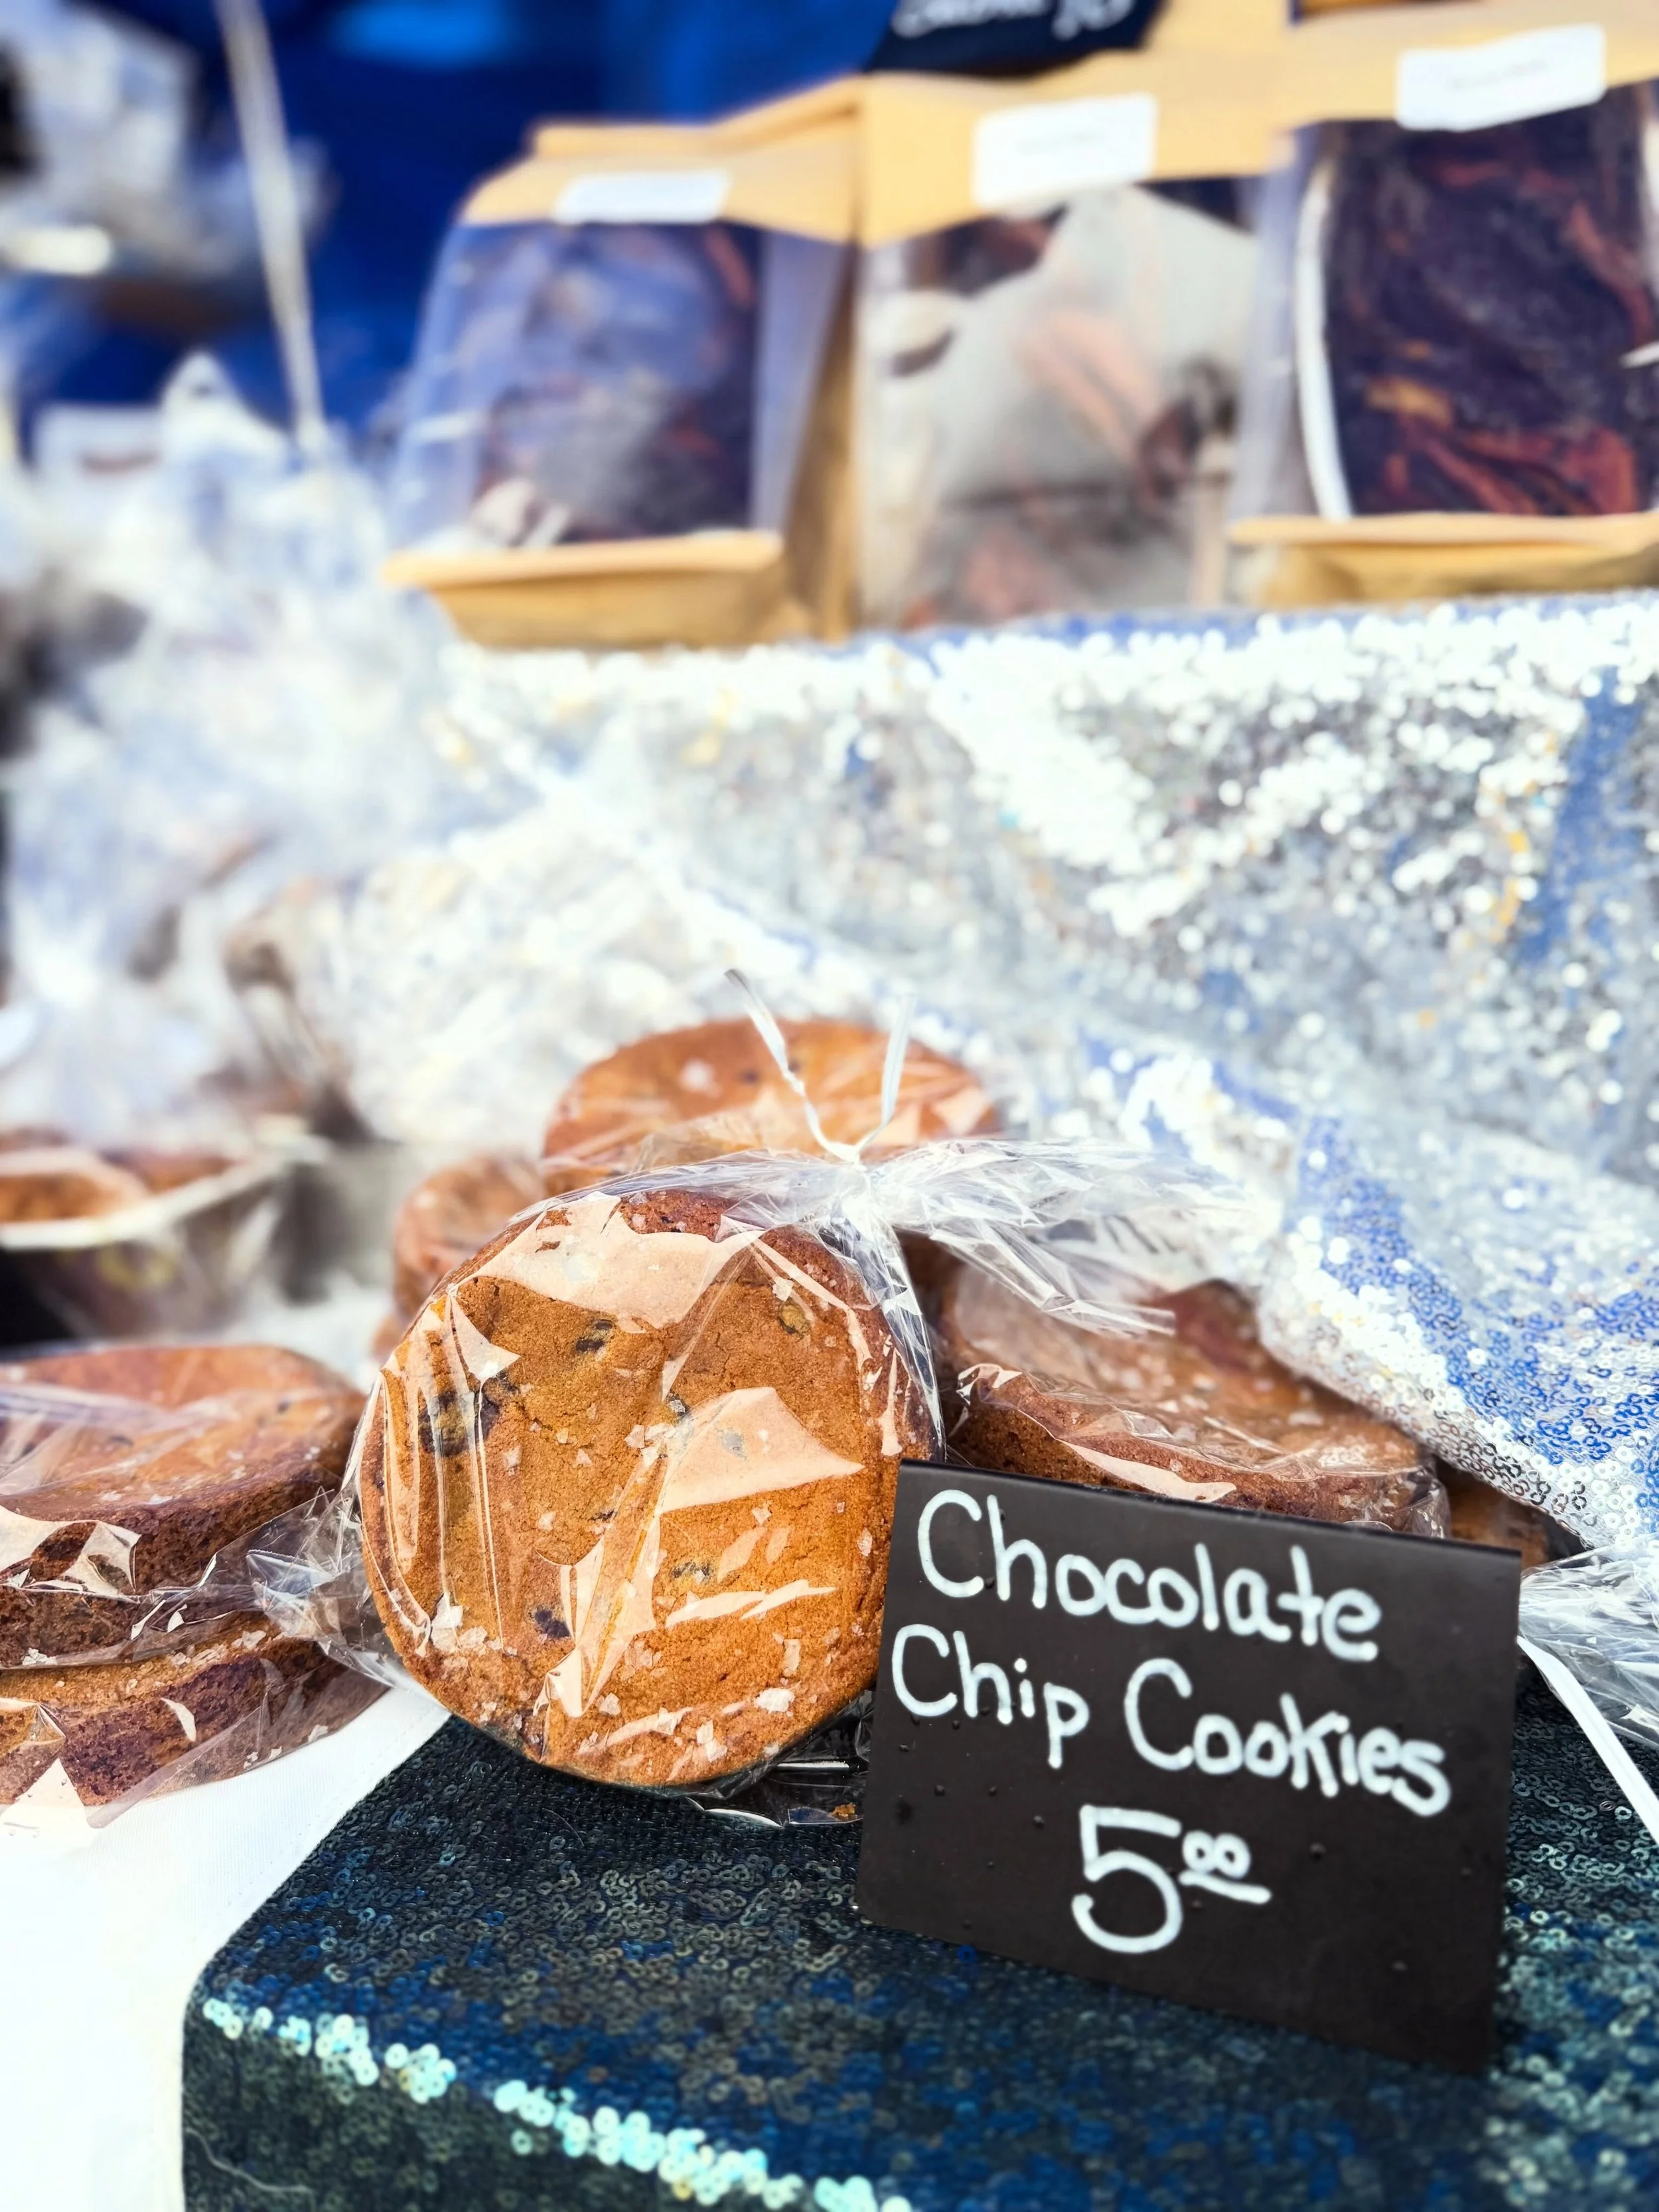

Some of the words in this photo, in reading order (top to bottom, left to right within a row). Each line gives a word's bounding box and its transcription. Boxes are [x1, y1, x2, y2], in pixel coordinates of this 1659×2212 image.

[918, 1489, 1382, 1662] Chocolate
[892, 1623, 1090, 1769] Chip
[1124, 1658, 1451, 1816] Cookies
